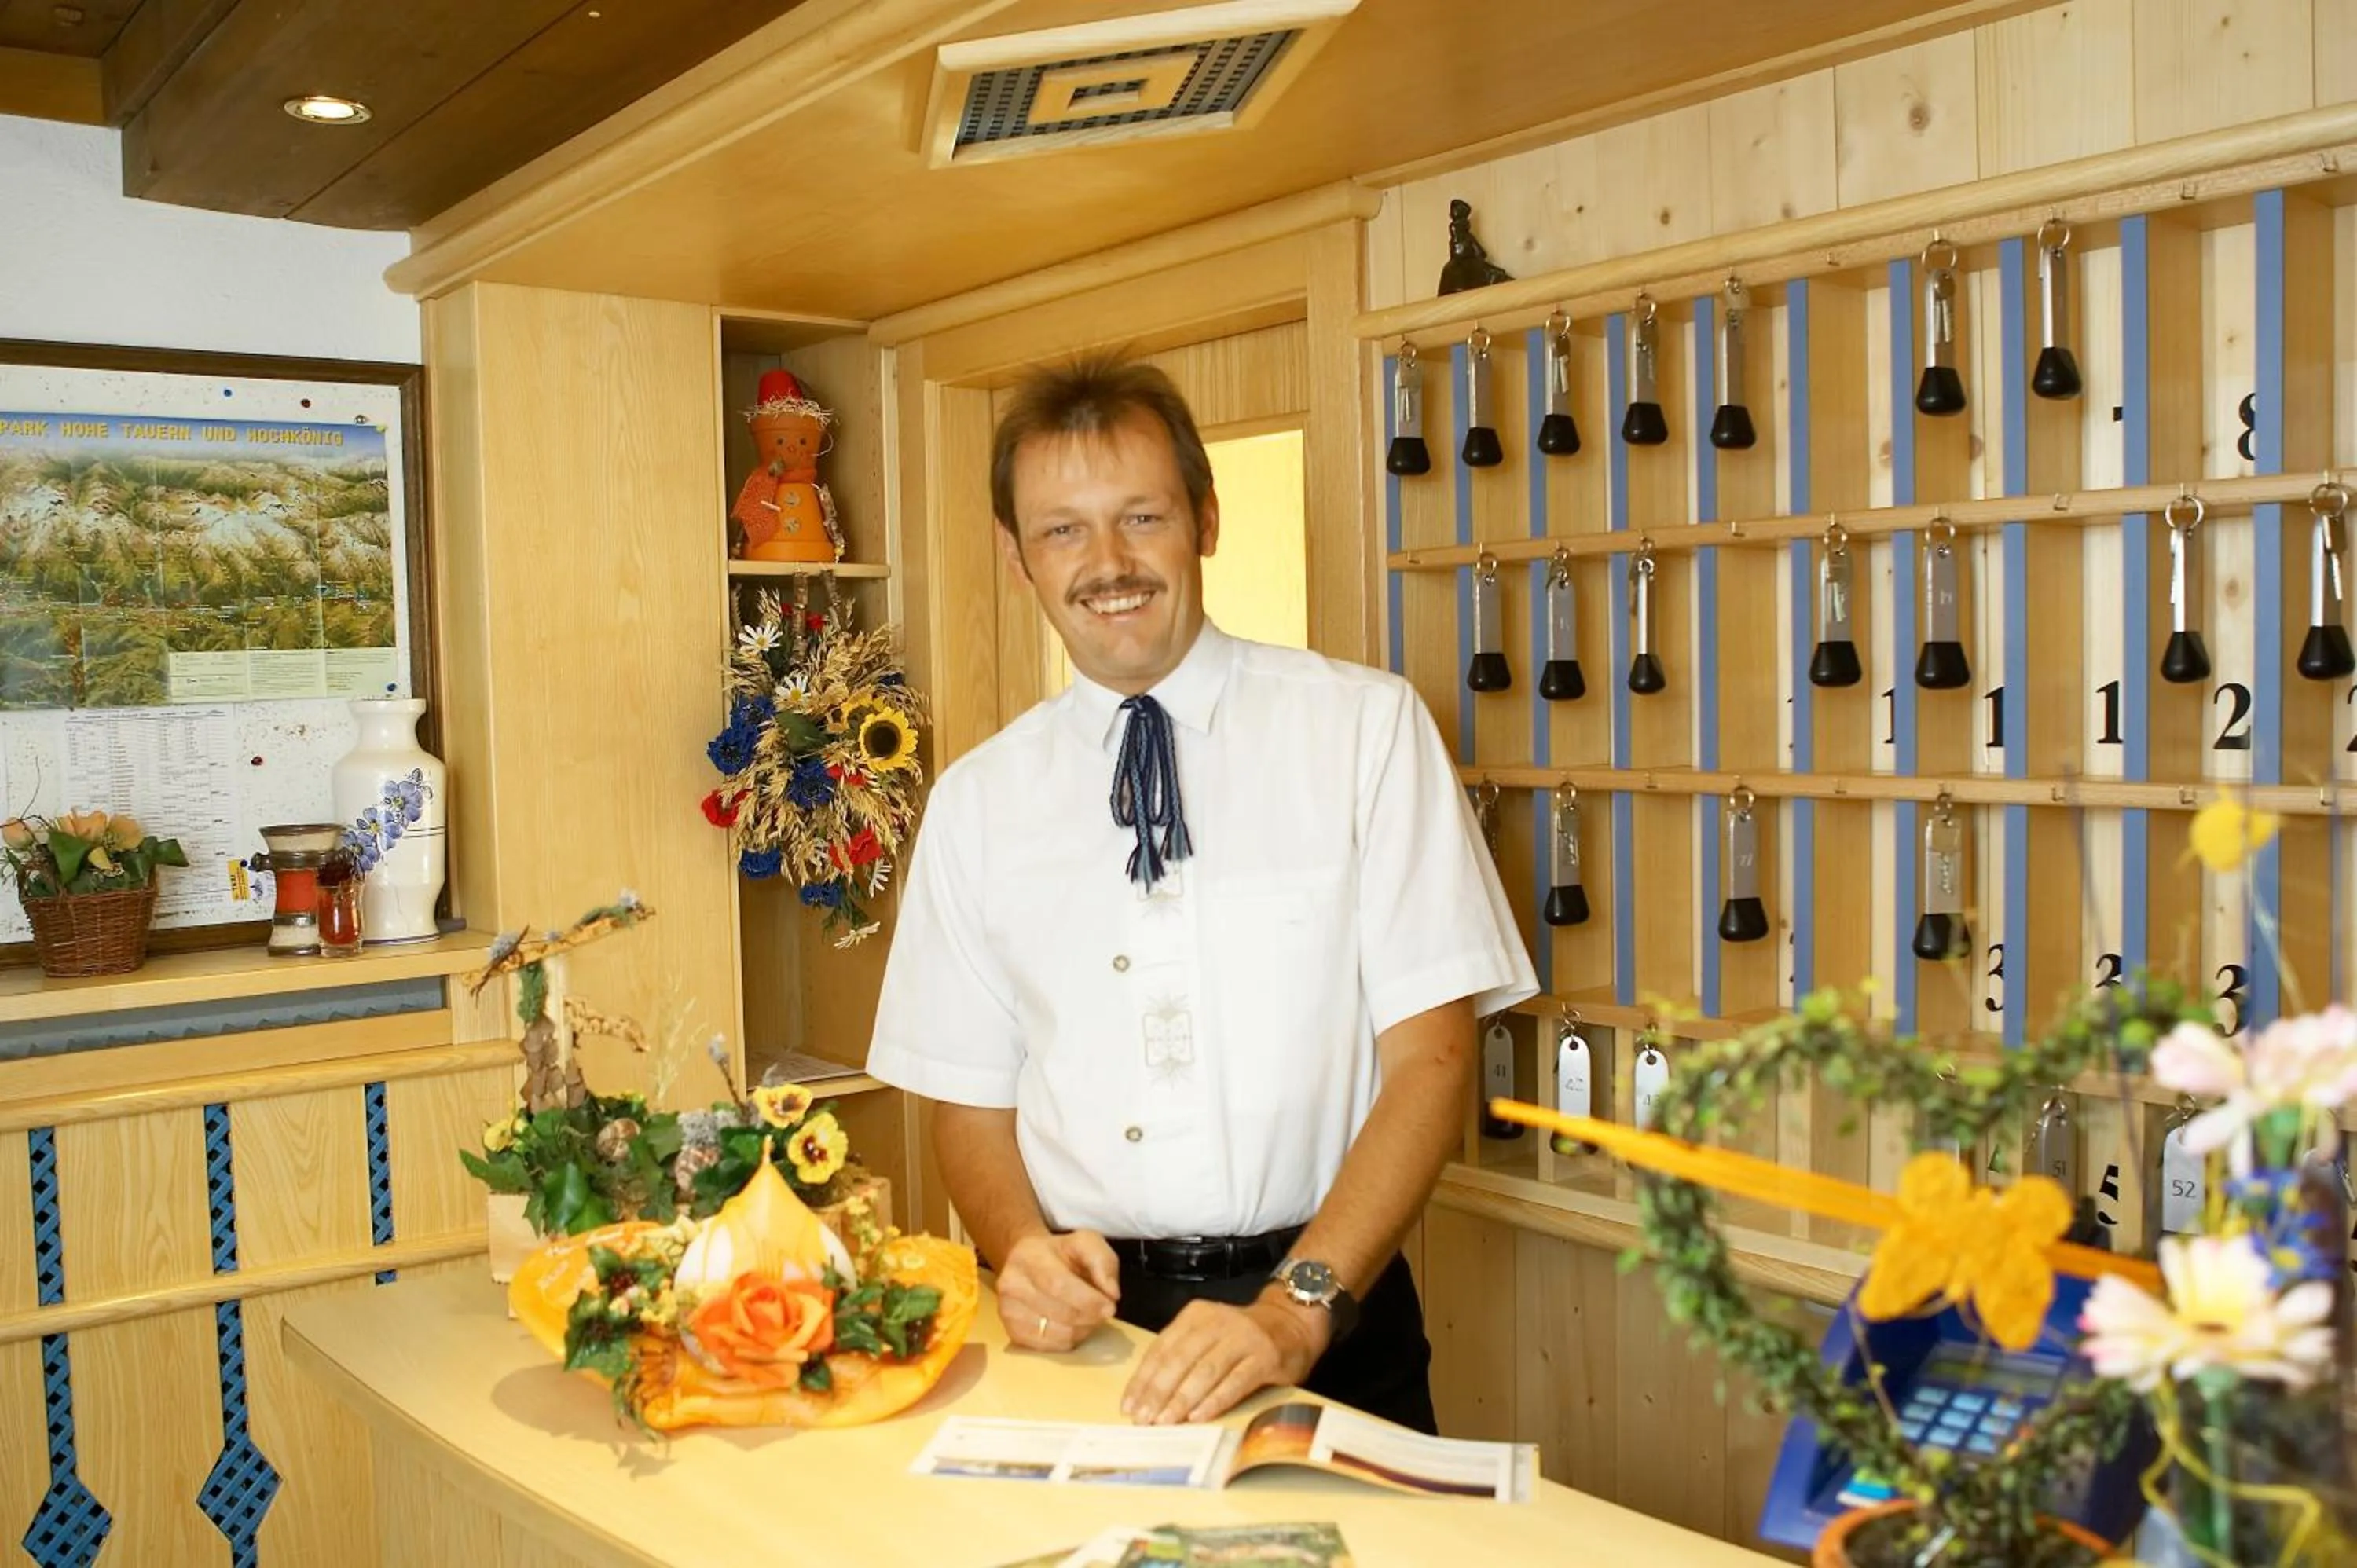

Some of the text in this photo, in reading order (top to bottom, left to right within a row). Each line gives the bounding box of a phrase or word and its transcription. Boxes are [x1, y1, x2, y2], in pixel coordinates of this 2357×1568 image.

[60, 421, 108, 439] HOHE
[122, 423, 192, 441] TAUERN
[203, 426, 237, 442] UND
[247, 427, 344, 447] HOCHKÖNIG
[2096, 680, 2124, 744] 1
[2213, 683, 2251, 750] 2
[2171, 1179, 2198, 1199] 52
